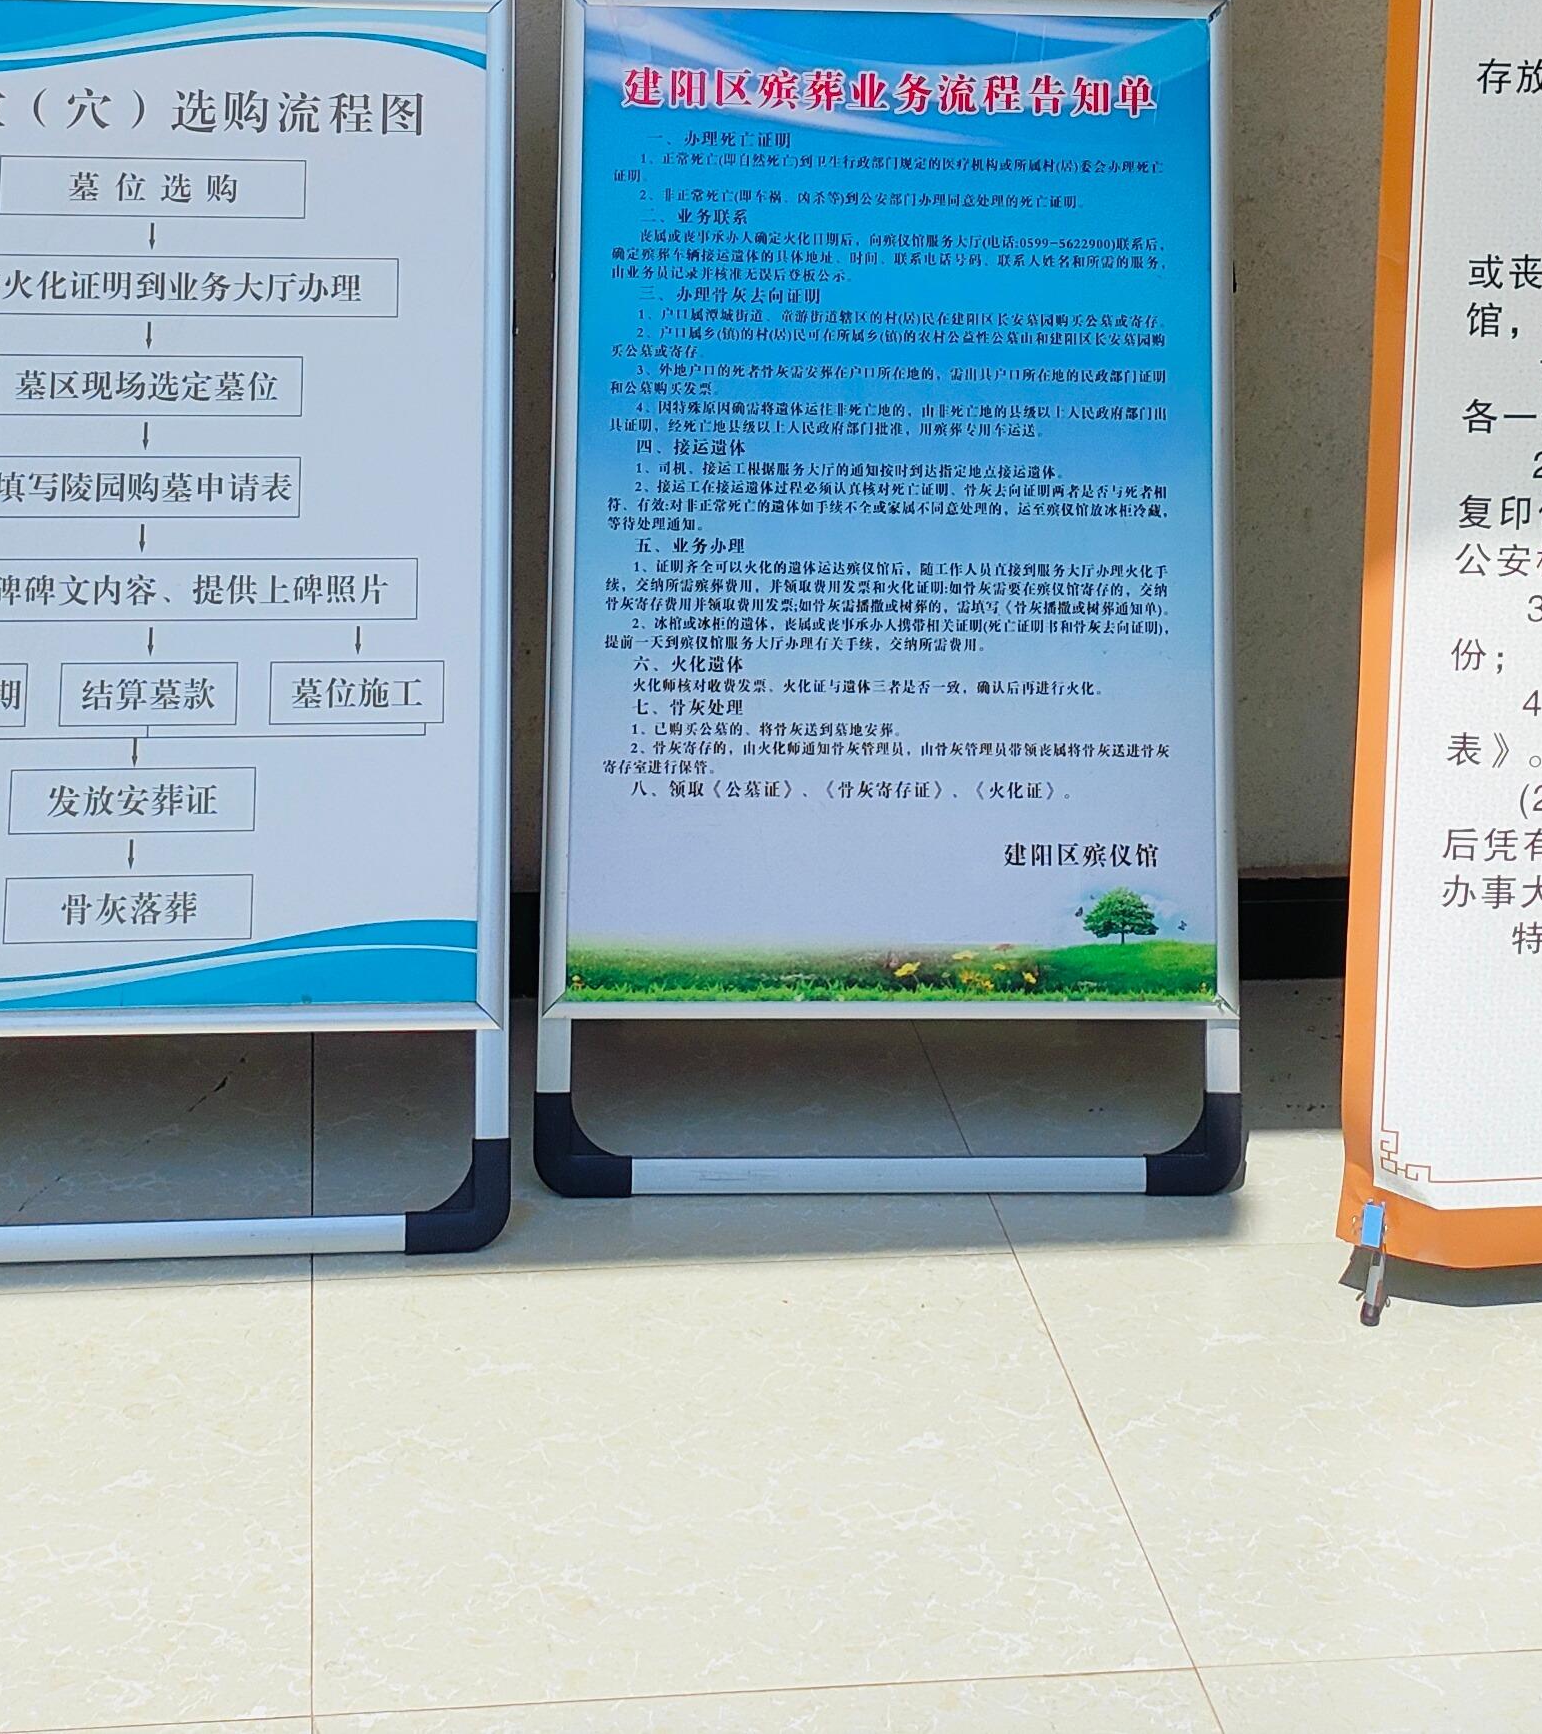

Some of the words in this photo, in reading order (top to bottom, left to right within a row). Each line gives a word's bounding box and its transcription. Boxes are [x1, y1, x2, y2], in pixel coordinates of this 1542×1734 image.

[623, 66, 1157, 117] 建阳区殡葬业务流程告知单
[68, 171, 238, 204] 墓位选购
[641, 207, 749, 227] 二、业务联系
[638, 285, 822, 305] 三、办理骨灰去向证明
[15, 369, 279, 402] 墓区现场选定墓位
[635, 438, 747, 457] 四、接运遗体
[607, 516, 705, 532] 等待处理通知。
[634, 536, 747, 556] 五、业务办理
[633, 655, 745, 674] 六、火化遗体
[81, 677, 216, 711] 结算墓款
[291, 676, 423, 709] 墓位施工
[632, 698, 745, 717] 七、骨灰处理
[602, 760, 717, 775] 寄存室进行保管。
[46, 783, 218, 818] 发放安葬证
[1003, 842, 1159, 868] 建阳区殡仪馆
[60, 890, 198, 926] 骨灰落葬
